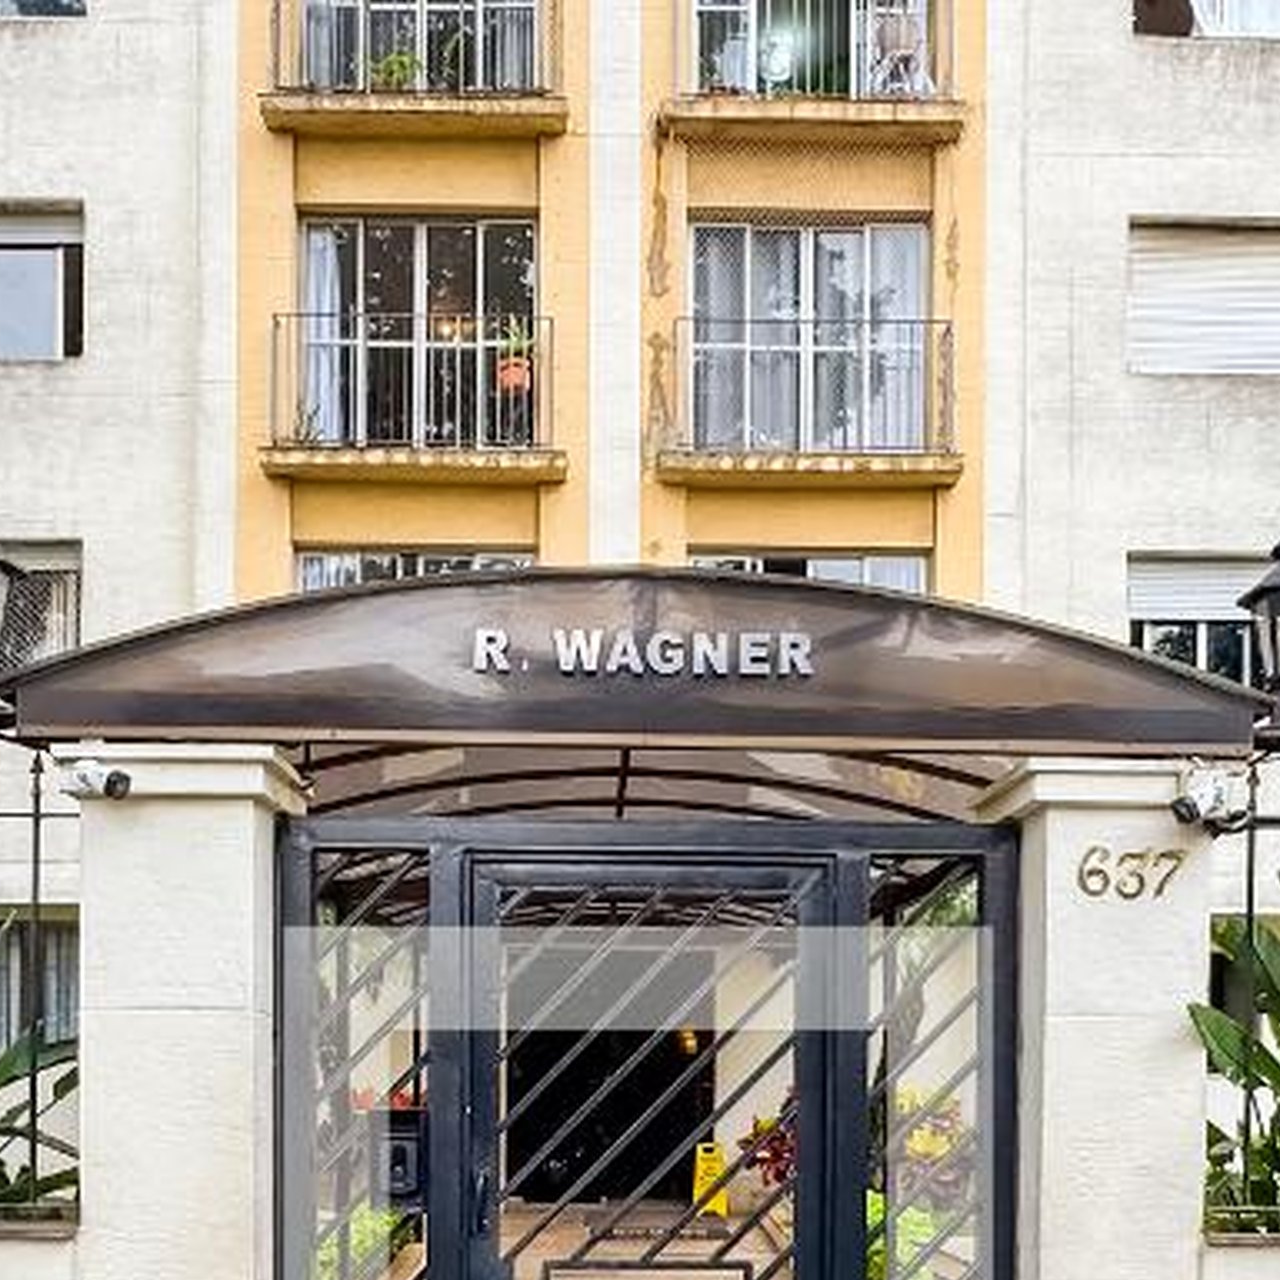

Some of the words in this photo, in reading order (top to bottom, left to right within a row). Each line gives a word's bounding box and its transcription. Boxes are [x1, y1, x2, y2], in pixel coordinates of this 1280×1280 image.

[473, 628, 529, 674] R.
[552, 629, 816, 677] WAGNER
[1078, 846, 1188, 900] 637
